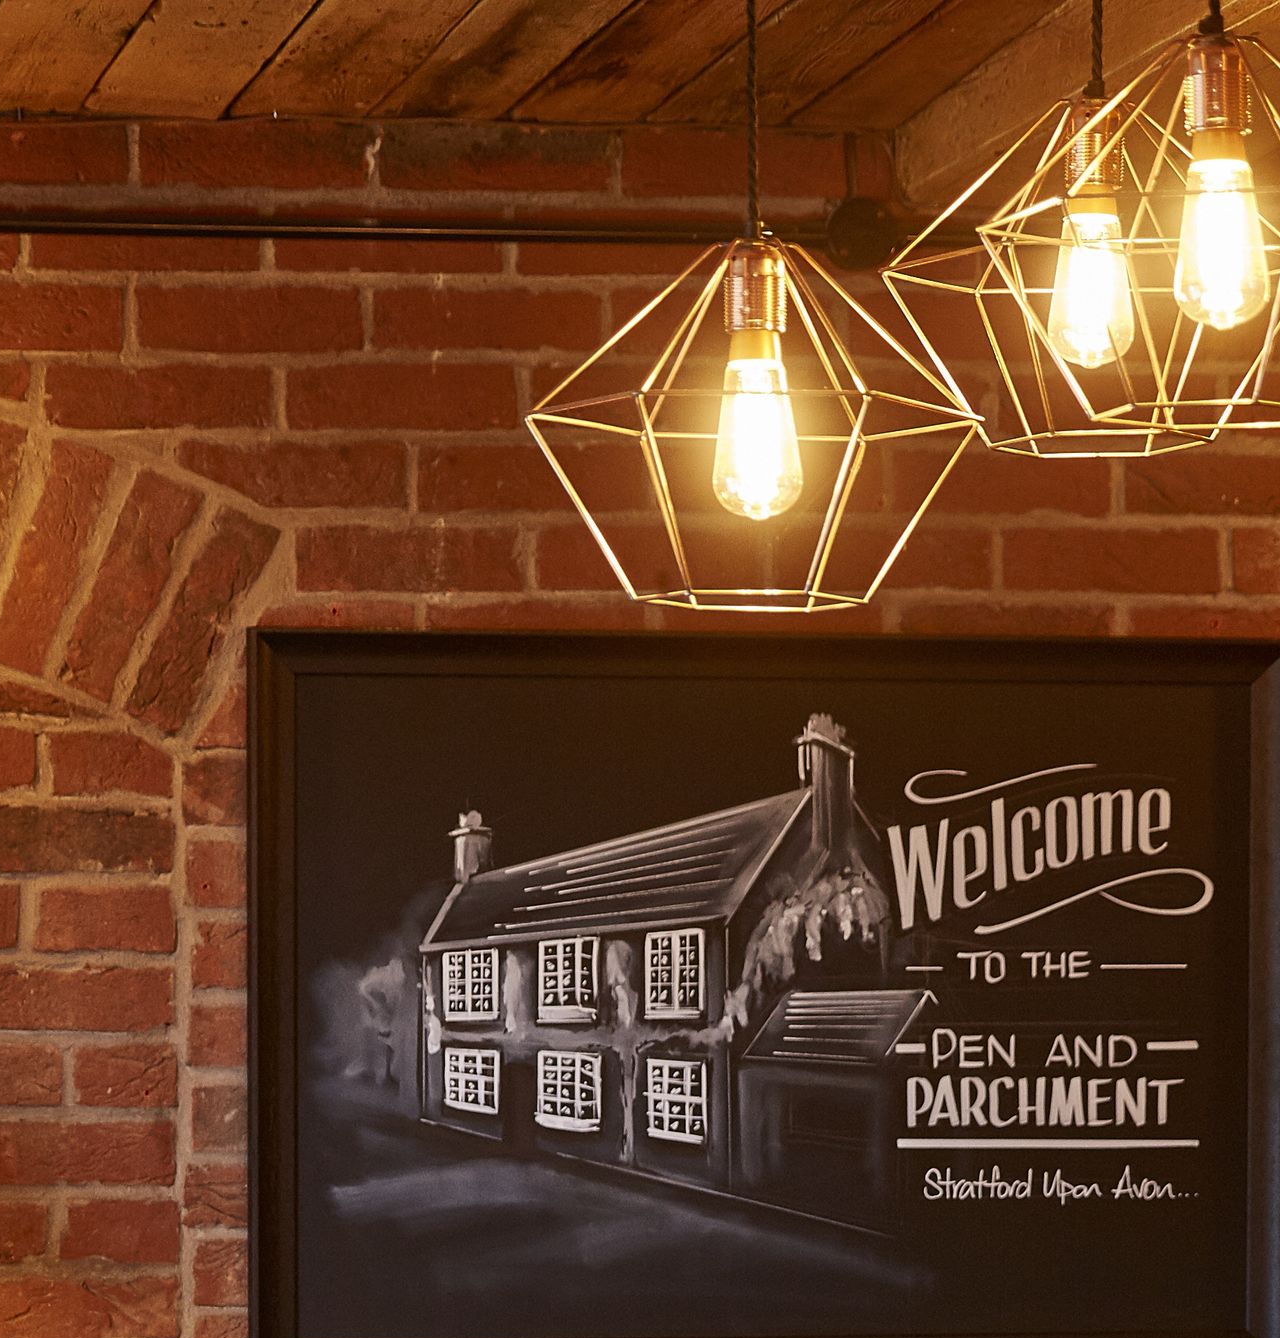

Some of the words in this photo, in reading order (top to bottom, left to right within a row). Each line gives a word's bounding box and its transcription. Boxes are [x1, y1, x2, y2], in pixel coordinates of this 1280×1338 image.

[887, 788, 1172, 930] Welcome
[957, 951, 1006, 983] TO
[1022, 951, 1092, 978] THE
[932, 1028, 1016, 1068] PEN
[1045, 1034, 1138, 1068] AND
[906, 1075, 1185, 1128] PARCHMENT
[923, 1165, 1032, 1200] Stratford
[1043, 1170, 1102, 1205] Upon
